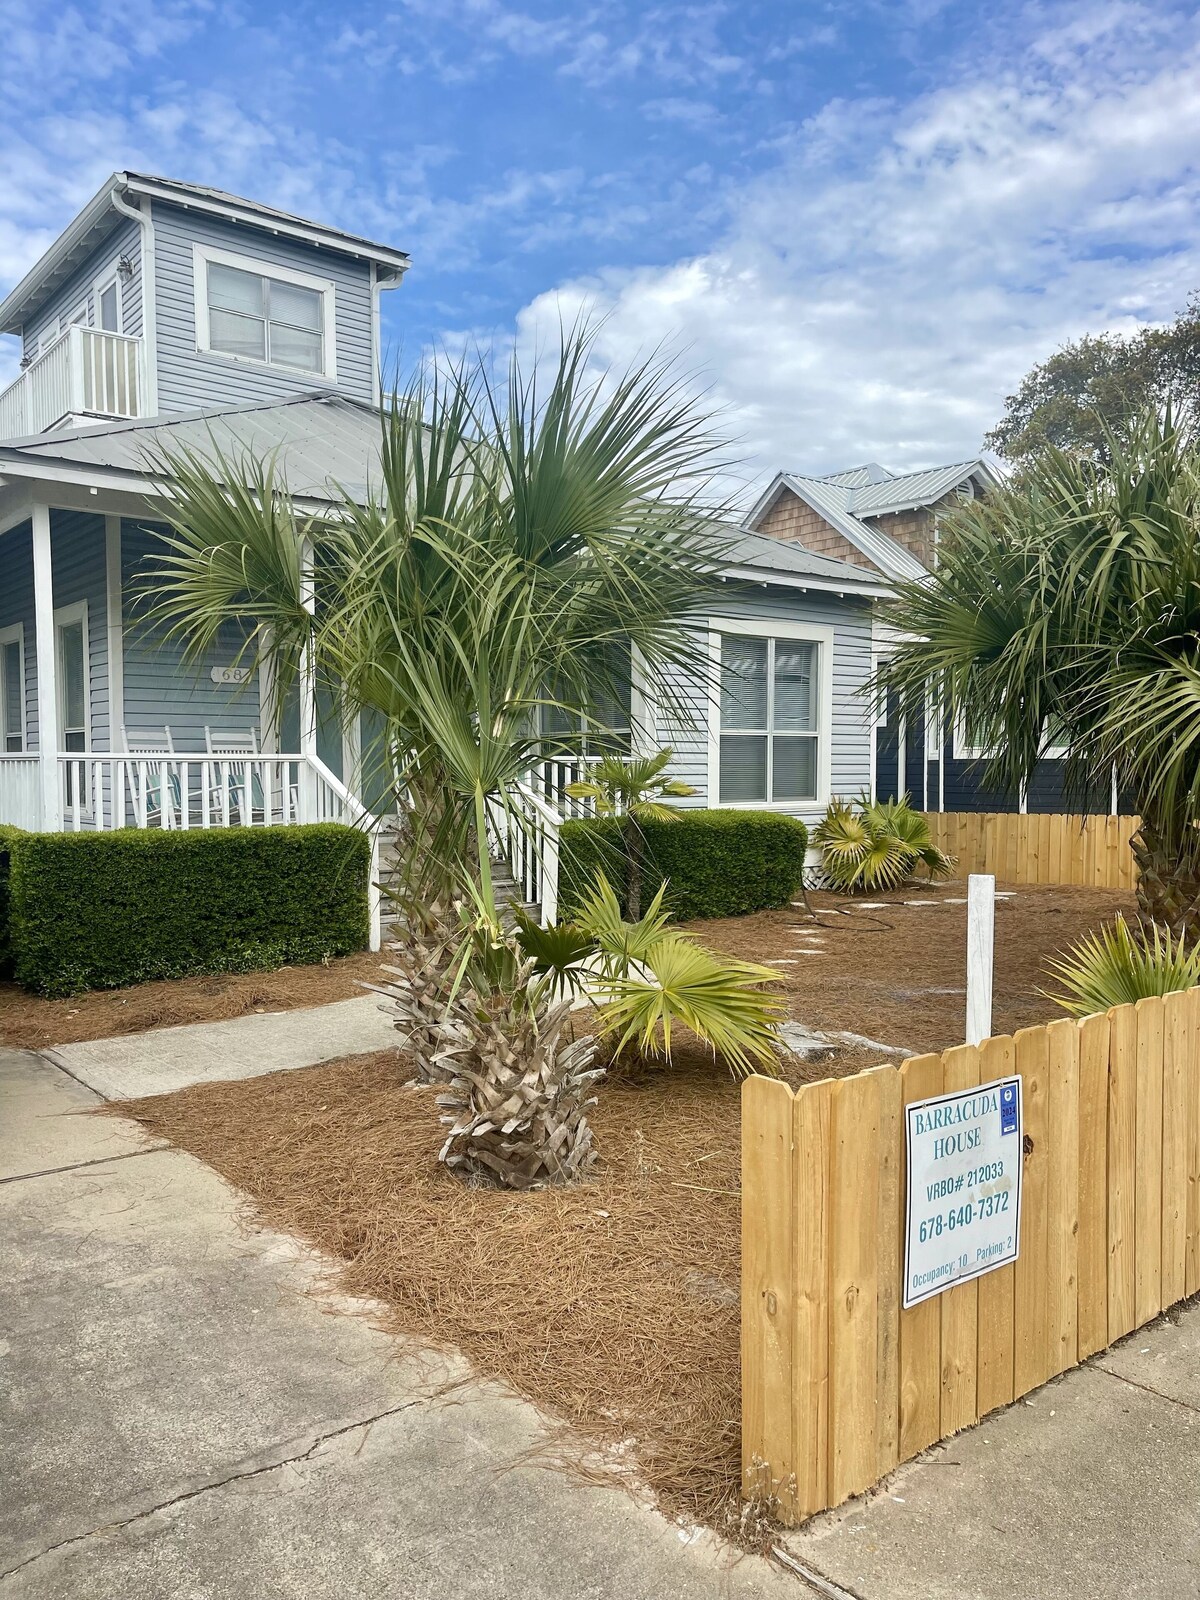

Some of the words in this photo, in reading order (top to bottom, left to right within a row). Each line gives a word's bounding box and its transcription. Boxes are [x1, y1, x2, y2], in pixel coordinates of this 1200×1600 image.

[222, 669, 242, 681] 68
[915, 1092, 998, 1135] BARRACUDA
[933, 1126, 982, 1160] HOUSE
[926, 1175, 964, 1202] VRBO#
[967, 1160, 1004, 1187] 212033
[919, 1191, 1009, 1243] 678-640-7372
[912, 1261, 956, 1288] Occupancy:
[958, 1253, 968, 1268] 10
[976, 1241, 1006, 1261] Parking:
[1007, 1236, 1012, 1249] 2
